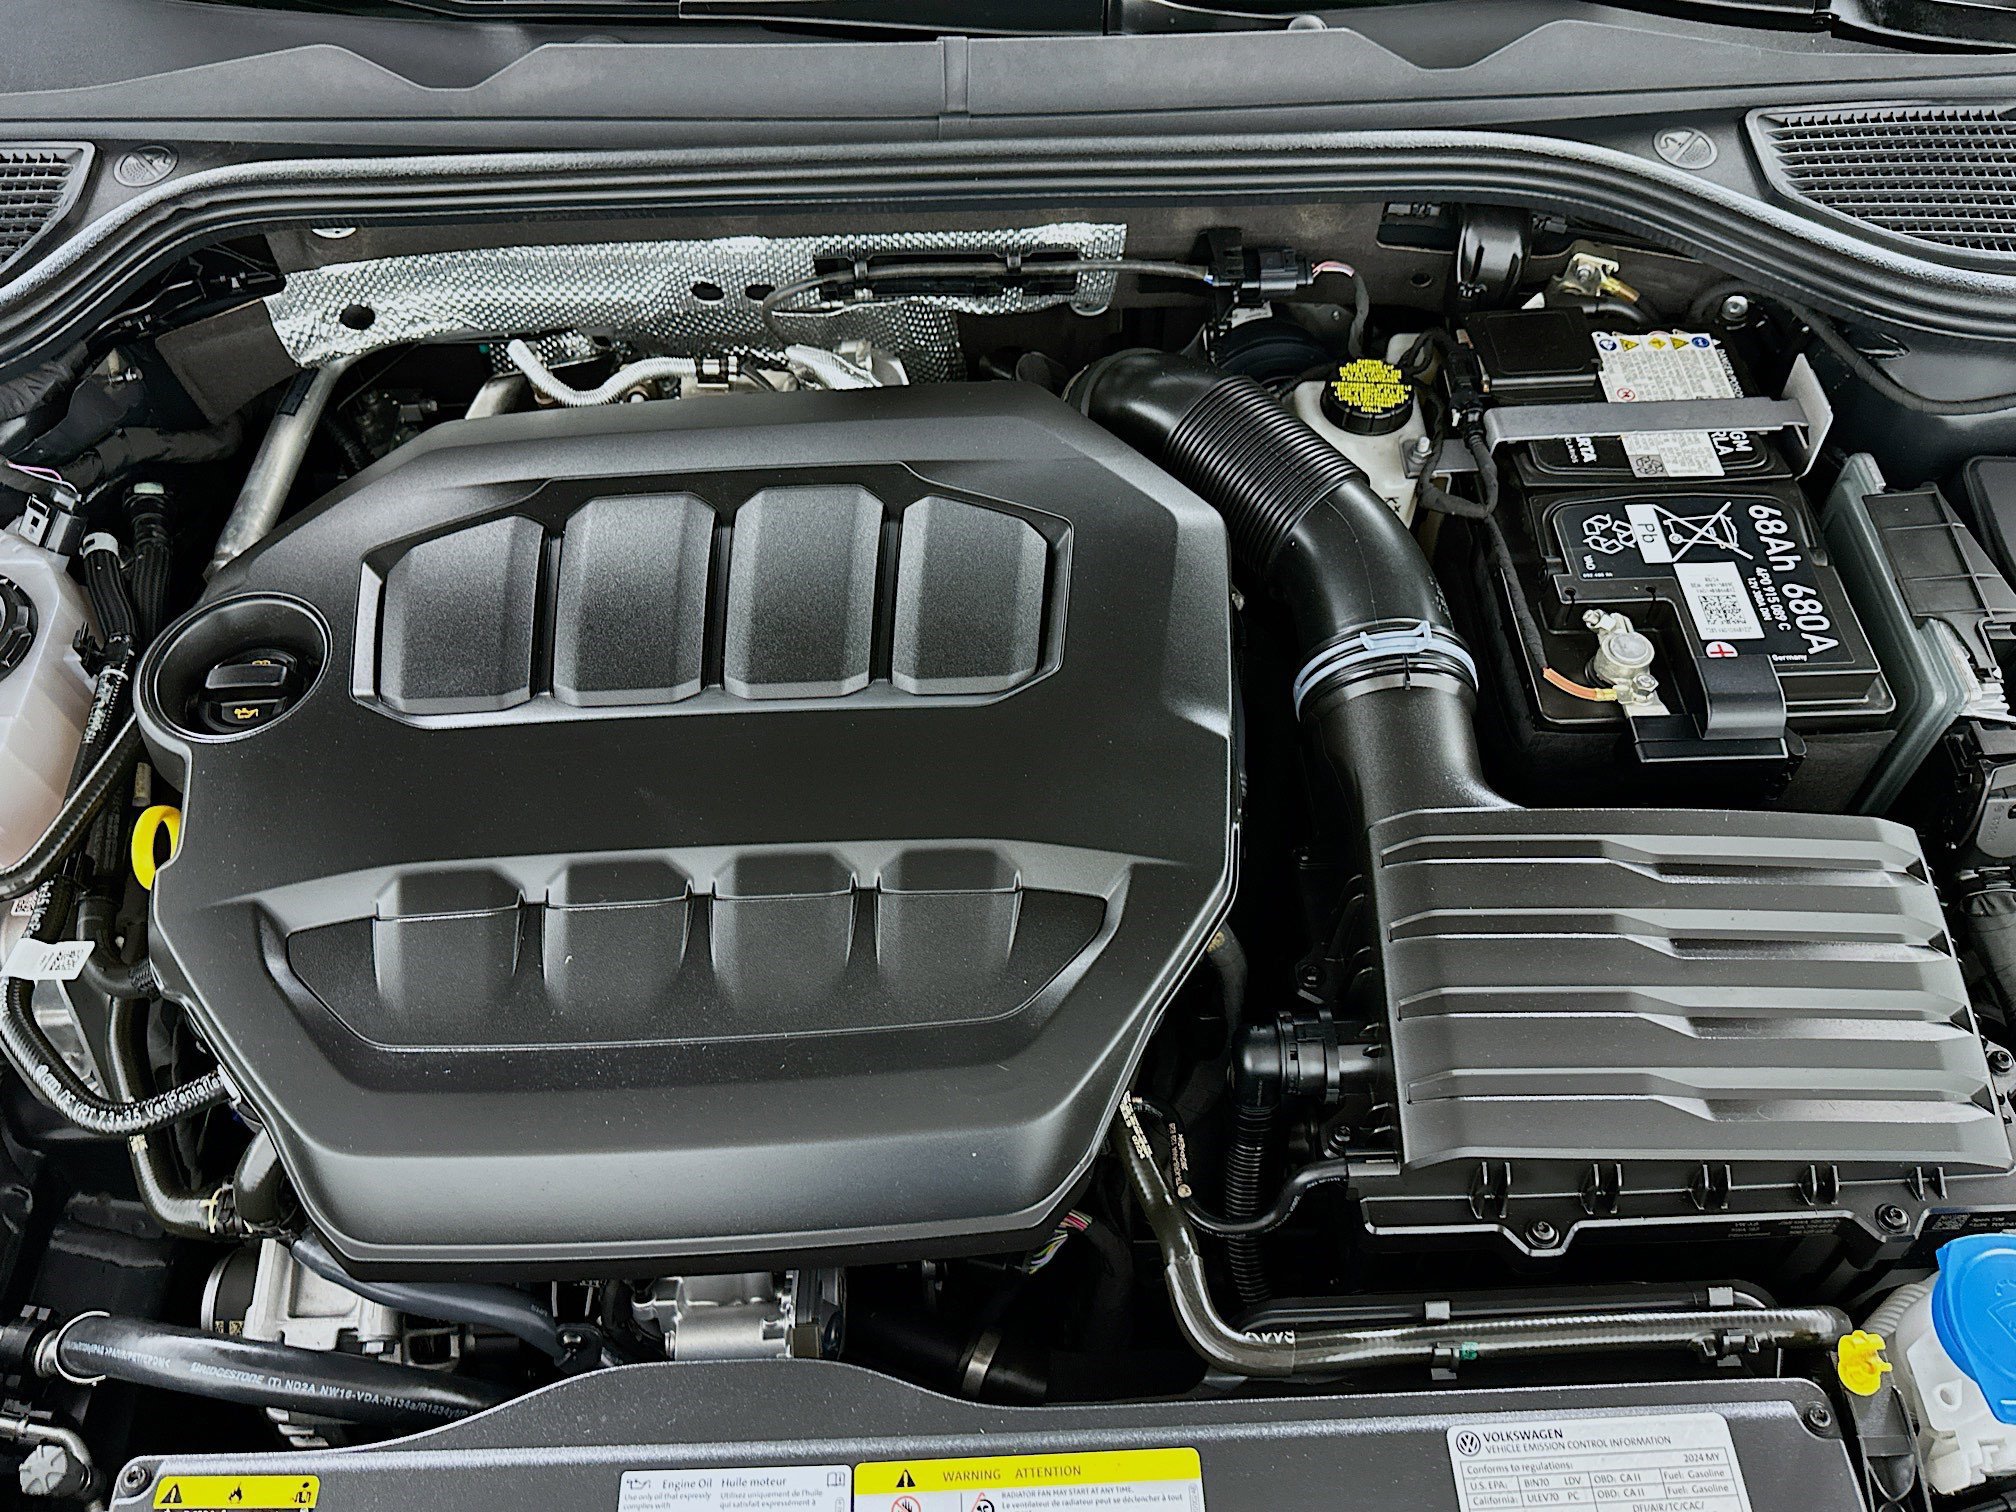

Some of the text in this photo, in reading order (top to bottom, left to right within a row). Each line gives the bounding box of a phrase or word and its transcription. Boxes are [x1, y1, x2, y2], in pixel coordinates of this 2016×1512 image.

[1711, 431, 1734, 456] RLA
[1728, 432, 1753, 452] GM
[1637, 522, 1656, 544] Pb
[1748, 504, 1839, 656] 68Ah 680A
[1778, 622, 1791, 632] C
[1772, 653, 1807, 662] Germany
[1483, 1428, 1564, 1442] VOLKSWAGEN
[1485, 1435, 1672, 1454] VEHICLE EMISSION CONTROL INFORMATION
[1683, 1452, 1720, 1463] 2024 MY
[1015, 1465, 1081, 1479] ATTENTION
[1467, 1461, 1573, 1474] Conforms to regulations:
[1664, 1467, 1725, 1480] Fuel: Gasoline
[943, 1468, 1001, 1482] WARNING
[1620, 1473, 1633, 1482] CA
[662, 1477, 712, 1491] Engine Oil
[721, 1476, 786, 1488] Huile moteur
[747, 1489, 790, 1499] uniquement
[1001, 1489, 1036, 1499] RADIATOR
[1038, 1489, 1051, 1497] FAN
[1053, 1488, 1067, 1496] MAY
[1069, 1487, 1089, 1495] START
[1100, 1486, 1114, 1494] ANY
[1568, 1491, 1580, 1500] PC
[1623, 1488, 1637, 1497] CA
[1667, 1483, 1729, 1495] Fuel: Gasoline
[720, 1501, 731, 1510] qui
[1012, 1500, 1050, 1509] ventilateur
[1062, 1498, 1093, 1507] radiateur
[1095, 1497, 1111, 1506] peut
[1168, 1493, 1183, 1501] tout
[1473, 1495, 1519, 1506] California:
